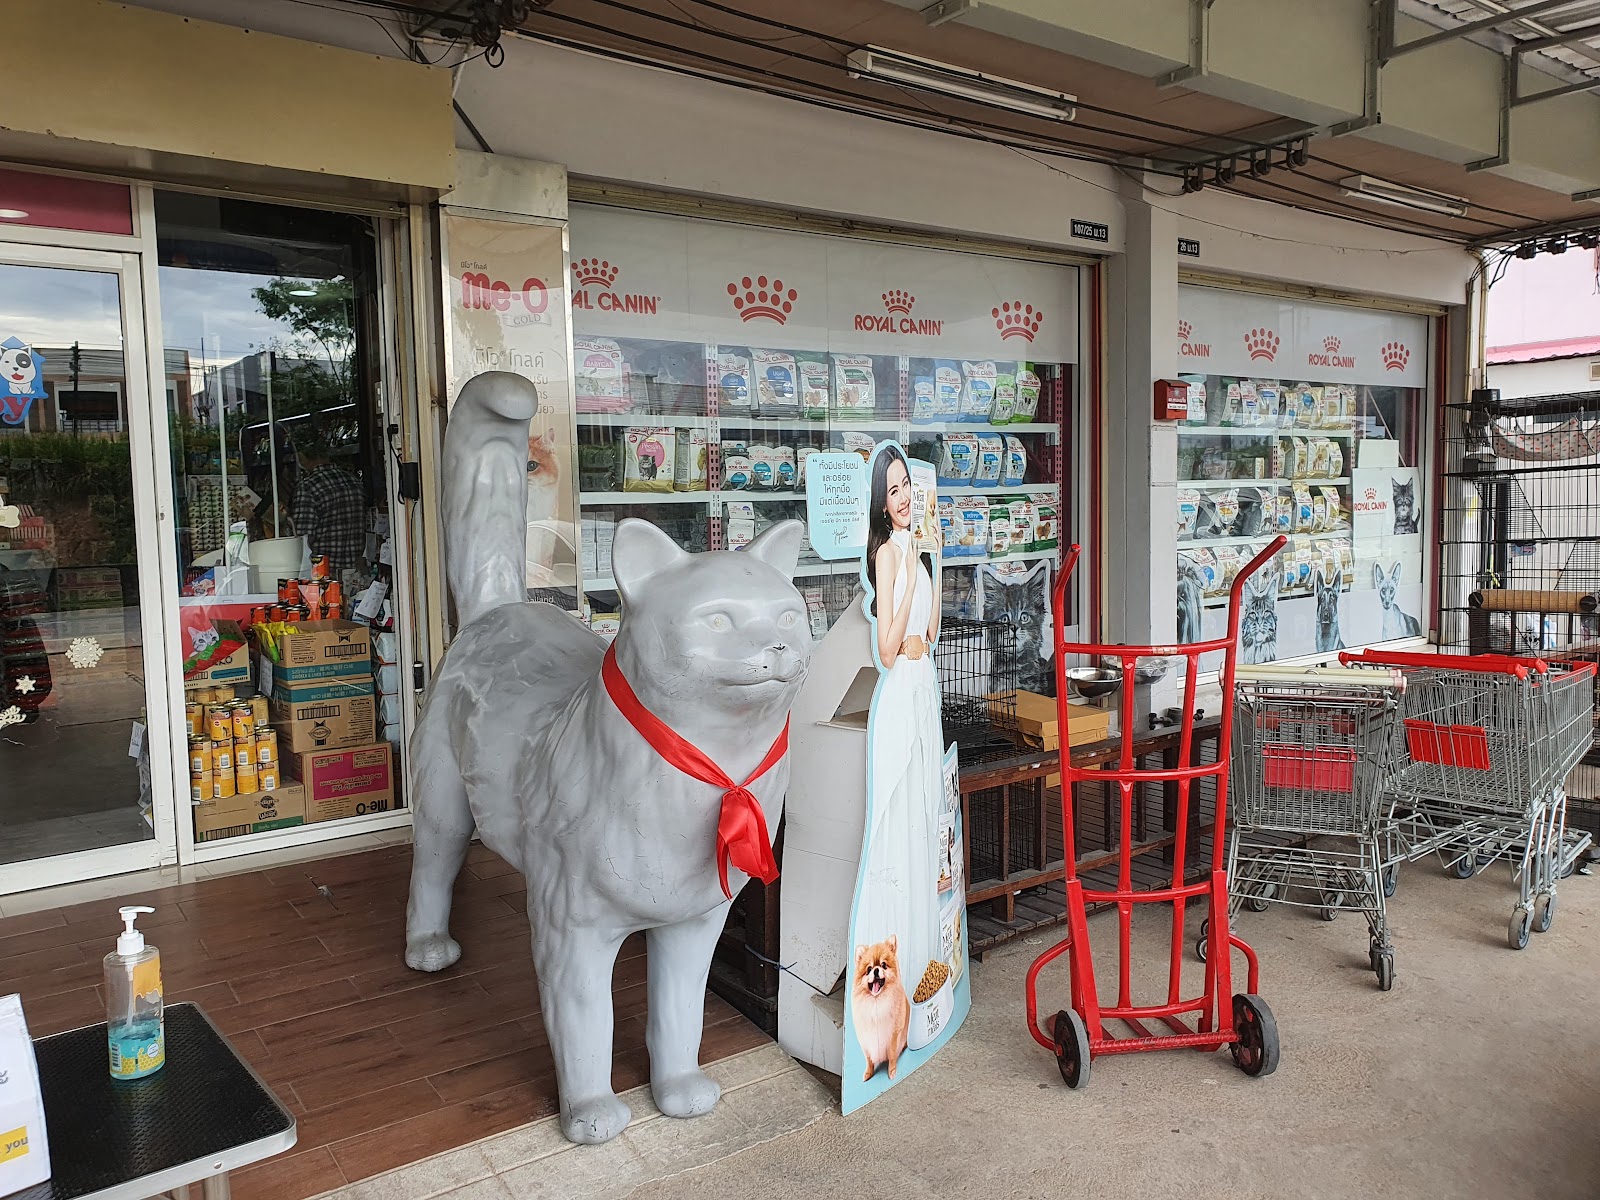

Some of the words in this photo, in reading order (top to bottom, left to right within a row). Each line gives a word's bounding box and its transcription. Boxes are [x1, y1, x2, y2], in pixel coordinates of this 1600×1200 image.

[1074, 224, 1092, 236] 107/25
[1093, 228, 1106, 239] ม.13
[1187, 243, 1198, 254] ม.13
[571, 289, 594, 309] AL
[597, 292, 657, 315] CANIN
[514, 314, 541, 326] GOLD
[854, 314, 897, 335] ROYAL
[900, 318, 942, 337] CANIN
[1181, 342, 1210, 358] CANIN
[510, 348, 544, 369] โกลด์
[1308, 353, 1331, 367] ROYAL
[1332, 355, 1355, 369] CANIN
[823, 473, 852, 482] และอร่อย
[1354, 502, 1370, 511] ROYAL
[1371, 501, 1387, 510] CANIN
[5, 1136, 28, 1154] you
